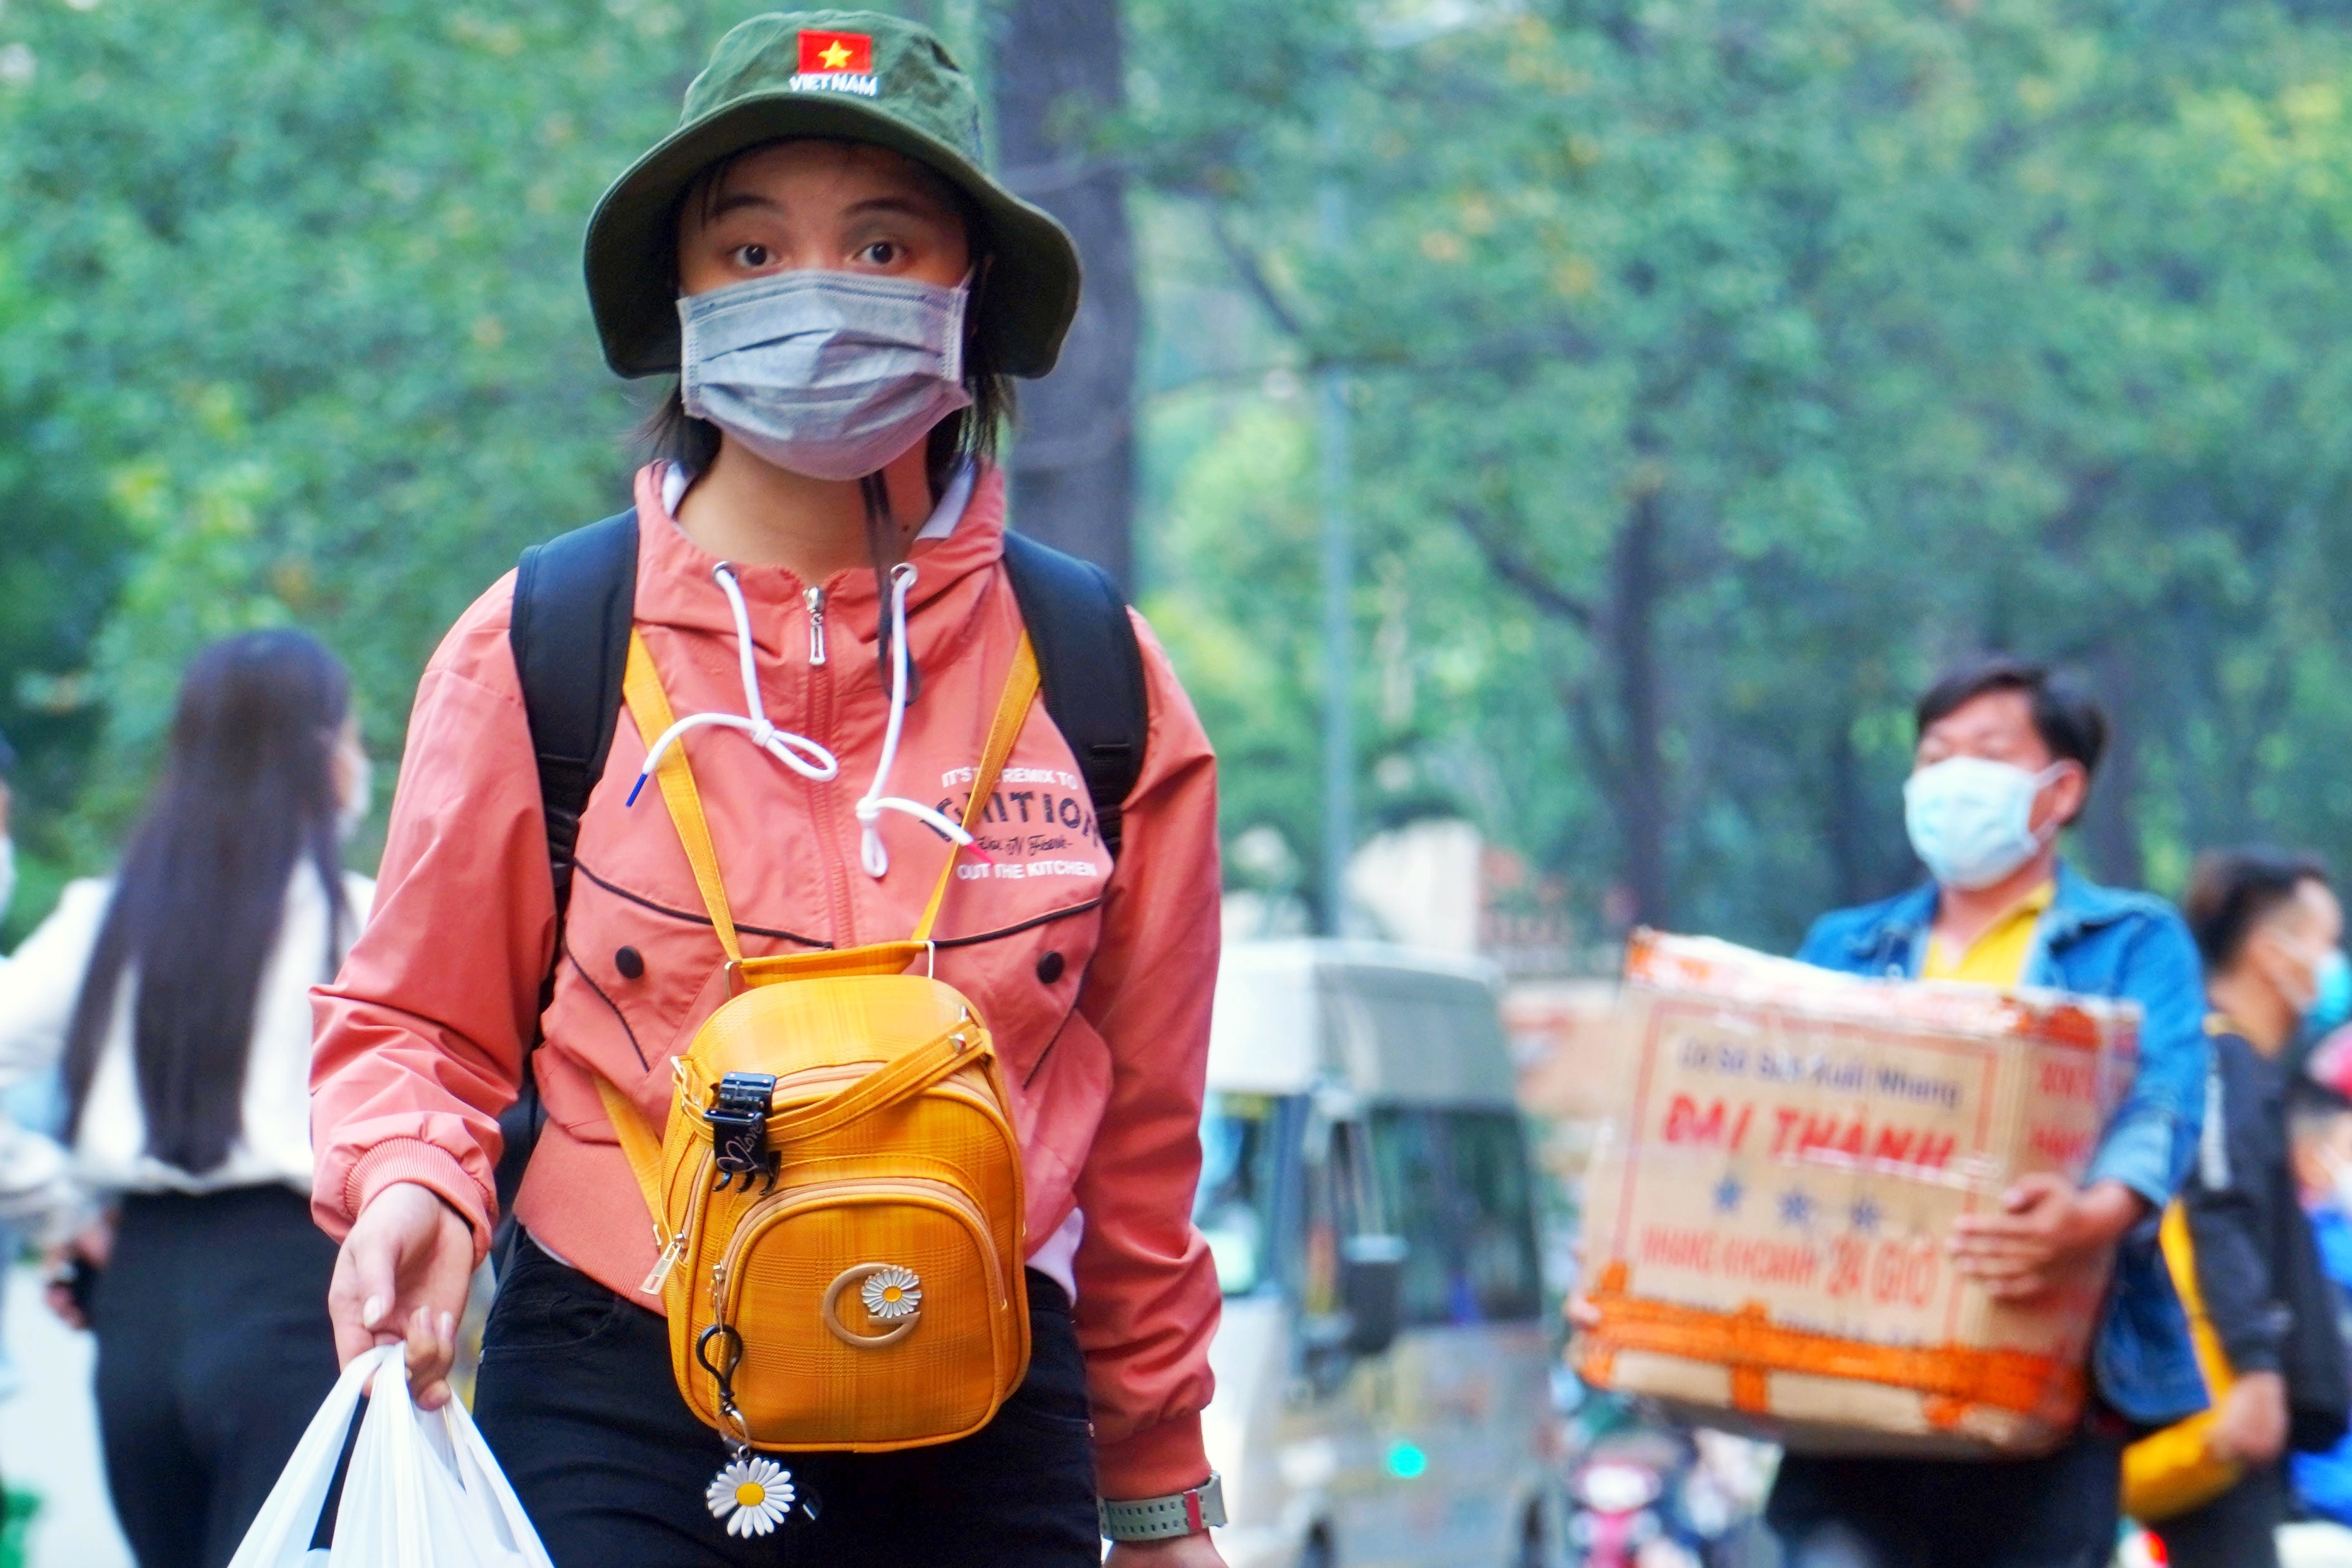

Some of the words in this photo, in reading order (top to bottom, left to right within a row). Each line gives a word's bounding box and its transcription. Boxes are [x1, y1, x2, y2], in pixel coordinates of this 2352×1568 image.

[789, 73, 878, 97] VIETNAM
[941, 766, 972, 788] IT'S
[1001, 768, 1057, 784] REMIX
[1055, 771, 1079, 790] TO
[956, 863, 990, 880] OUT
[994, 863, 1025, 879] THE
[1026, 860, 1097, 878] KITCHEN
